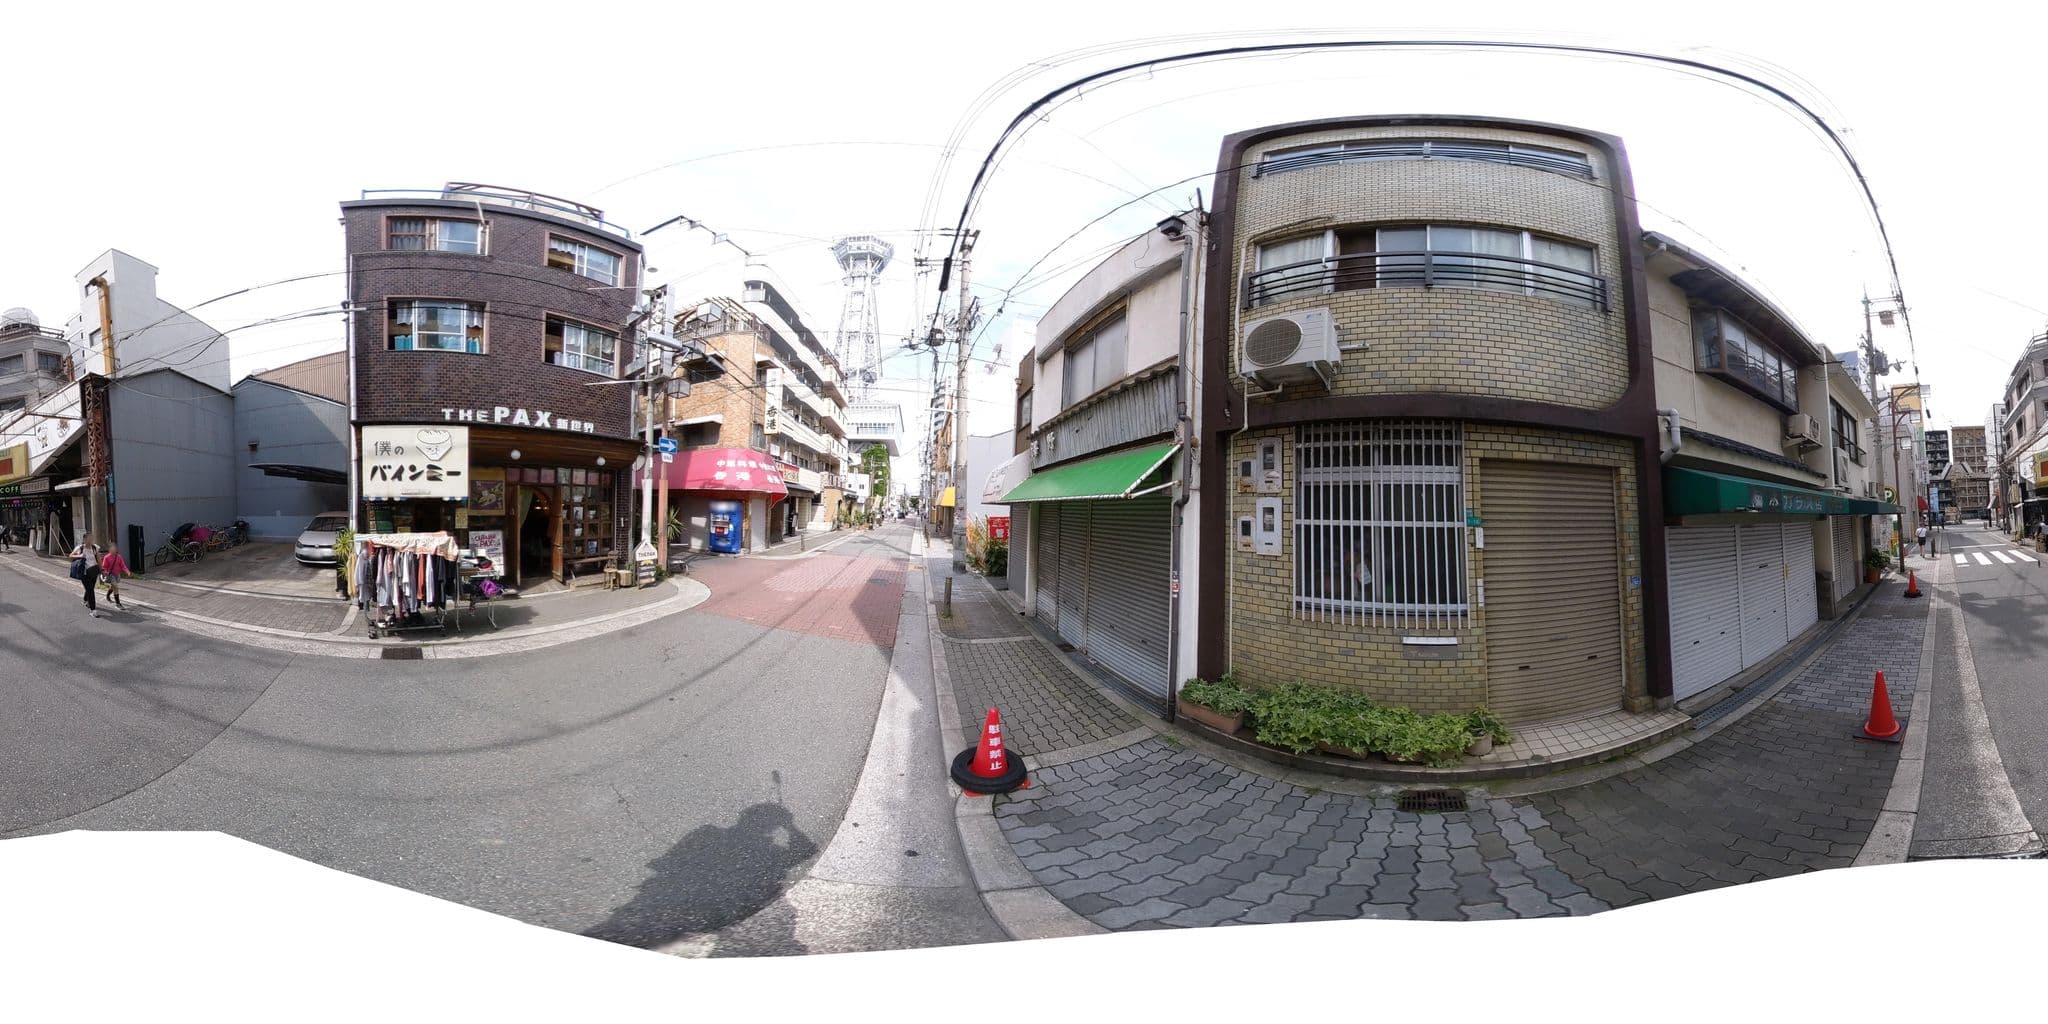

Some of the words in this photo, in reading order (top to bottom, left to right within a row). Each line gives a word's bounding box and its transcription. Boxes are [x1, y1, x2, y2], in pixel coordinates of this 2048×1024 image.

[441, 408, 488, 422] THE
[493, 406, 552, 428] PAX
[556, 418, 594, 434] 新世界
[374, 440, 404, 456] 僕の
[370, 464, 461, 481] バインミー
[1885, 490, 1892, 502] P
[988, 724, 1002, 771] 駐車禁止
